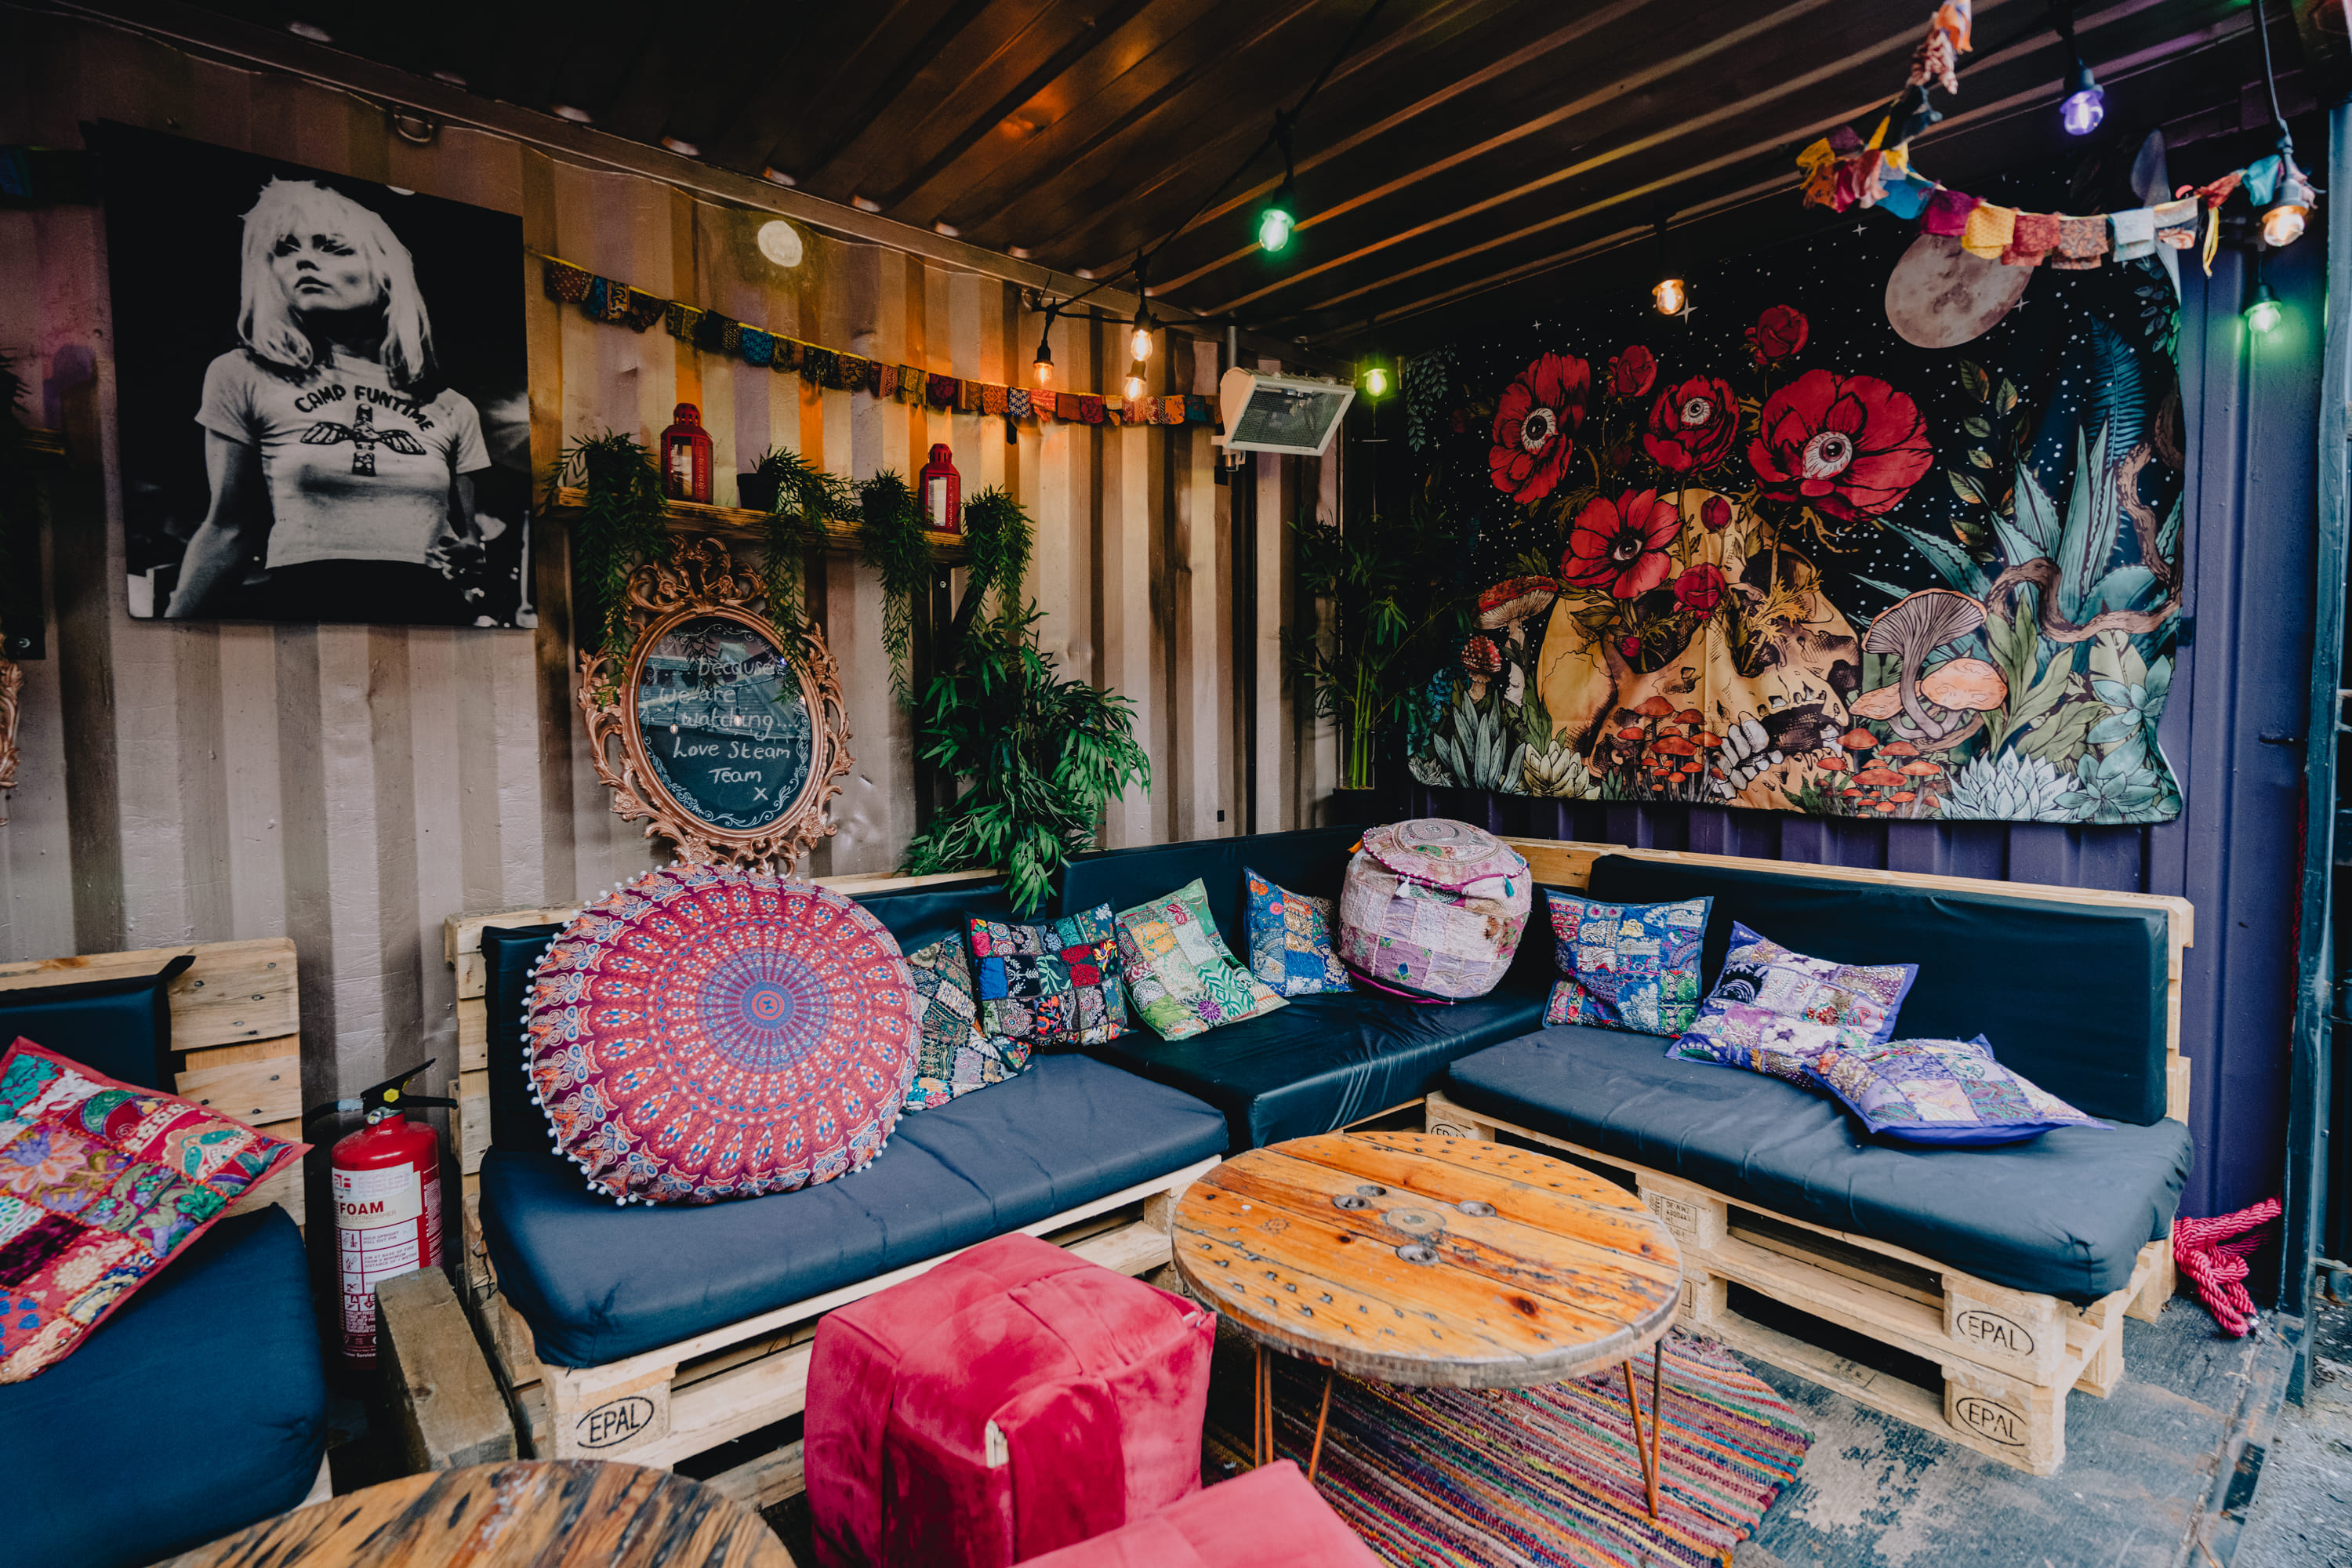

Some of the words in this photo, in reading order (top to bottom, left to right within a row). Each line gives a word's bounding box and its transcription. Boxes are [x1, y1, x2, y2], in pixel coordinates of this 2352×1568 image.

[295, 384, 347, 413] CAMP
[354, 385, 435, 431] FUNTIME
[699, 654, 776, 676] because
[659, 688, 693, 703] we
[699, 688, 735, 703] are
[673, 736, 720, 758] Love
[728, 741, 790, 759] Steam
[708, 767, 762, 784] Team
[339, 1201, 383, 1215] FOAM
[1969, 1316, 2018, 1351] EPAL
[590, 1403, 640, 1443] EPAL
[1969, 1403, 2018, 1441] EPAL
